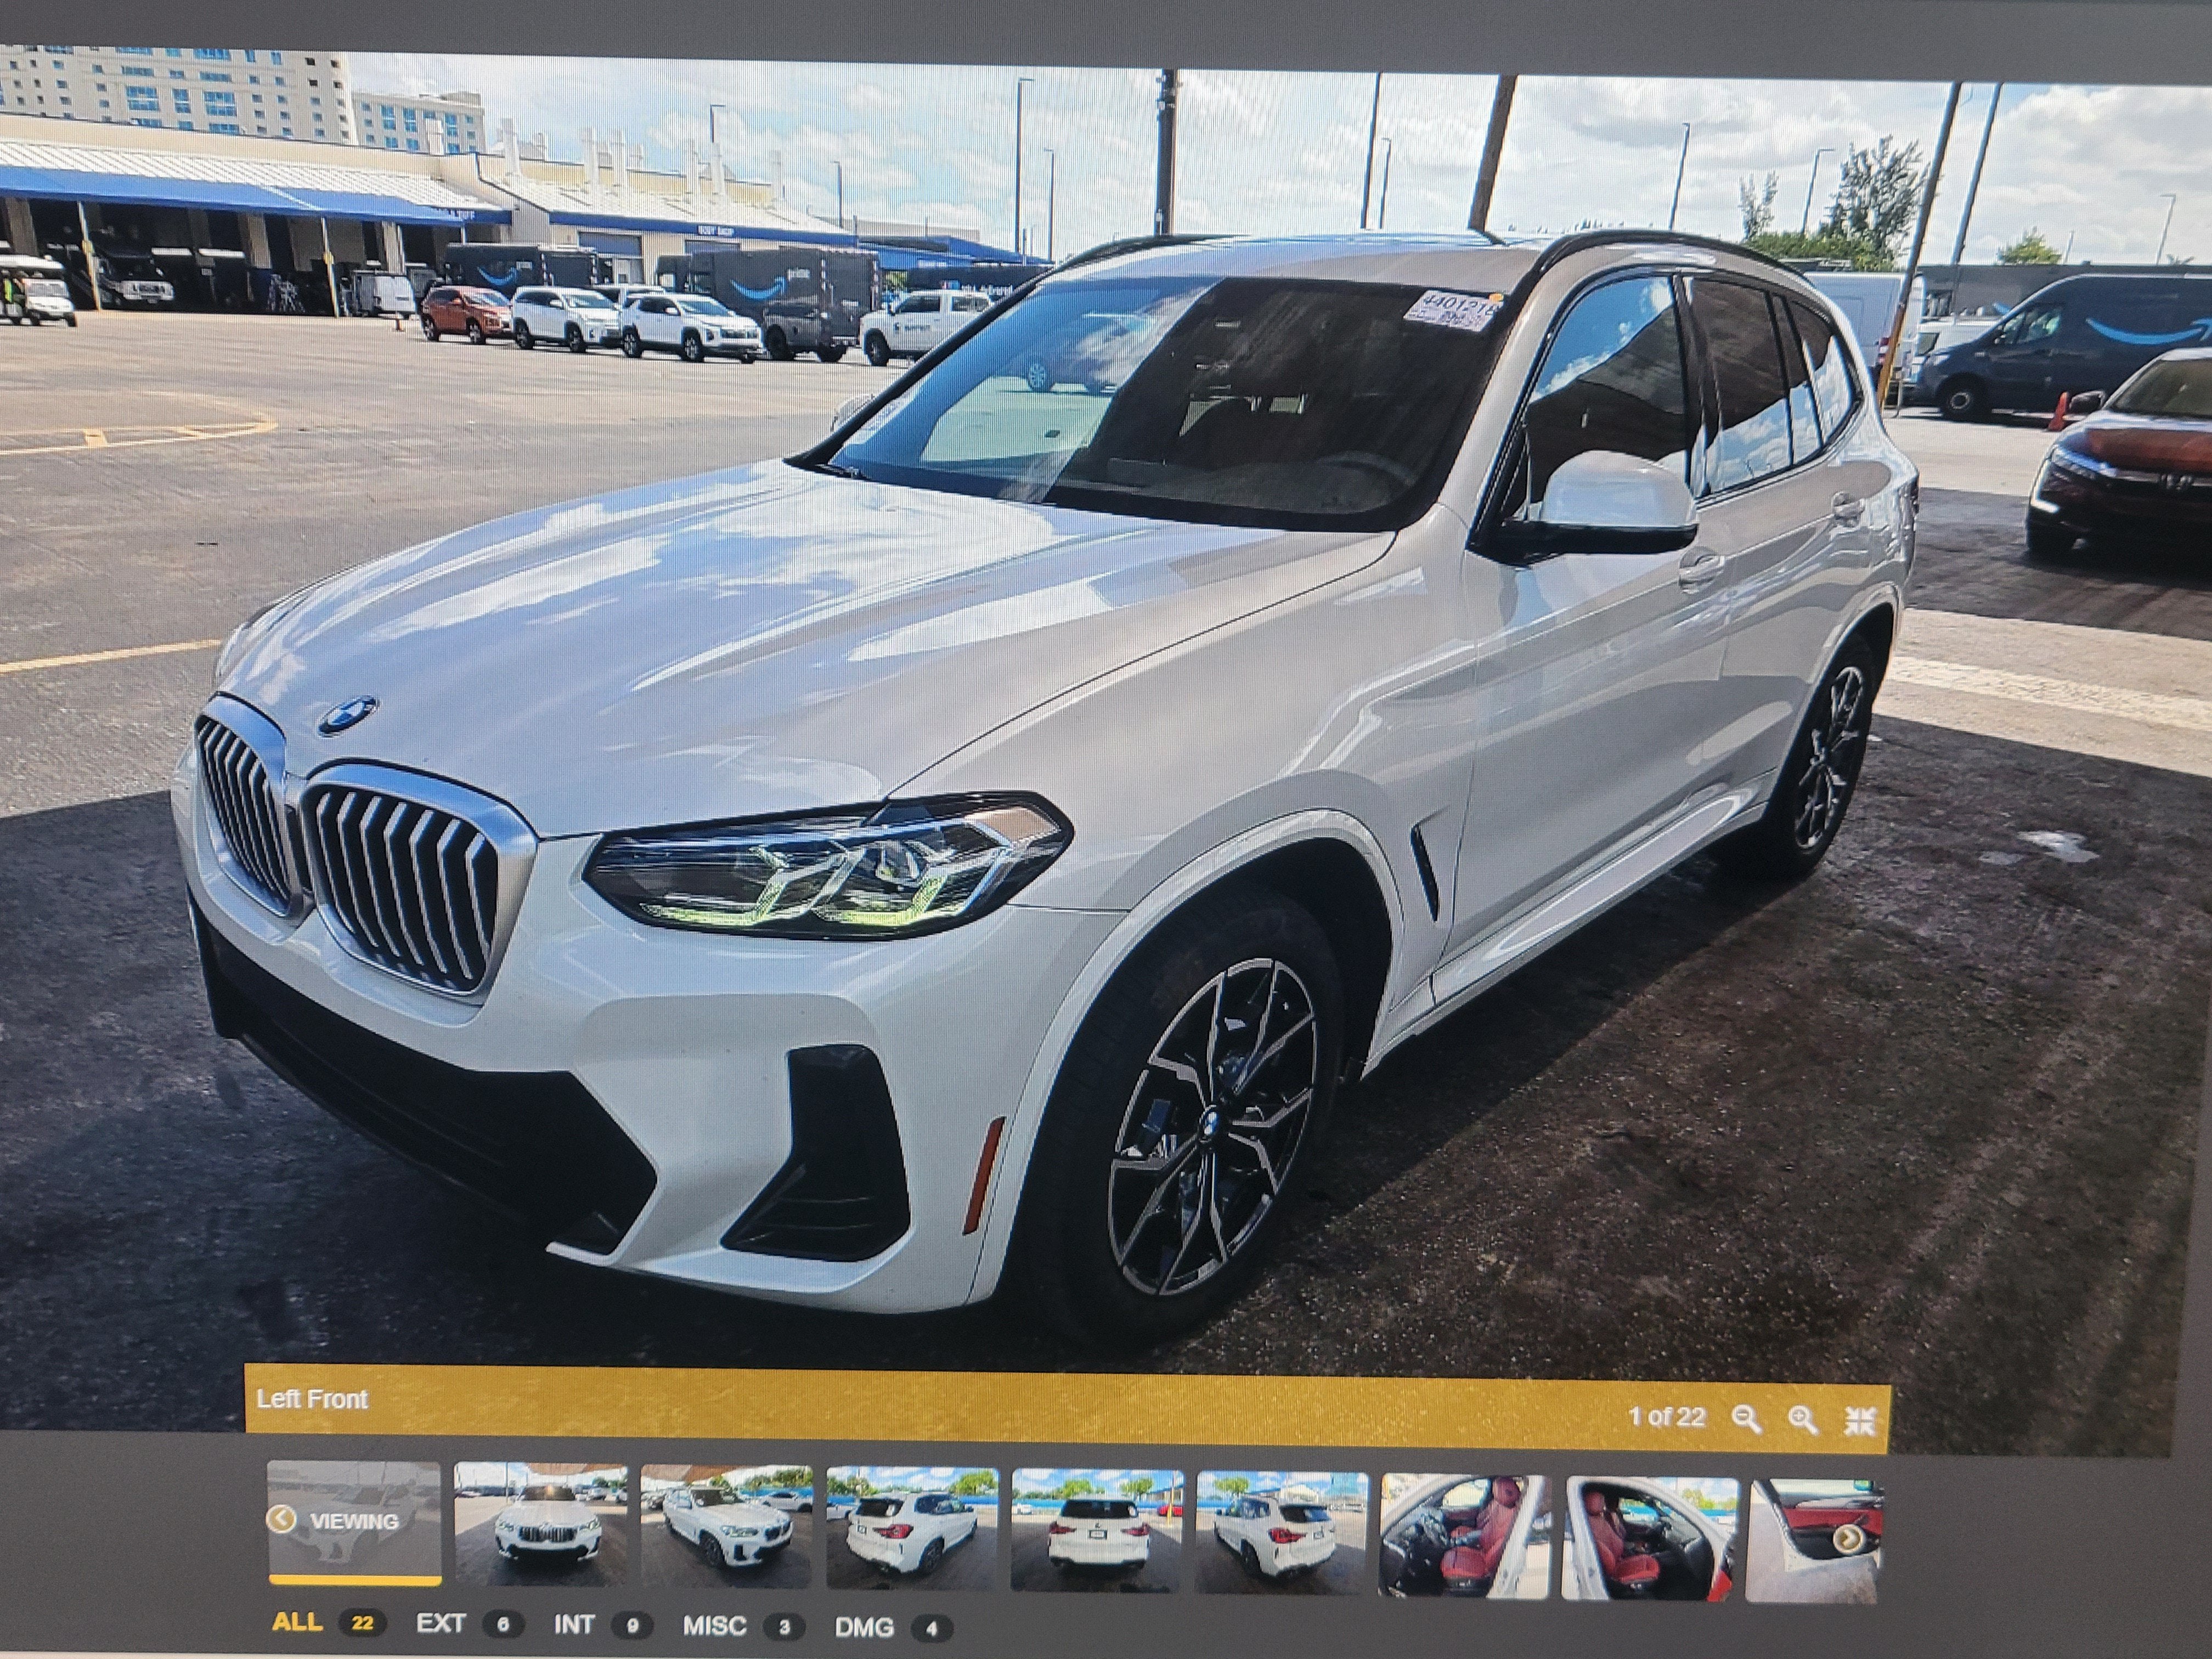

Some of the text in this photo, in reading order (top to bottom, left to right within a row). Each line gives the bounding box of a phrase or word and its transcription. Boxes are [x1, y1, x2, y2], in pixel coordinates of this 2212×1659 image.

[257, 1388, 369, 1409] Left Front
[1629, 1405, 1706, 1426] 1 of 22
[310, 1513, 399, 1530] VIEWING
[272, 1612, 374, 1631] ALL 22
[417, 1613, 509, 1633] EXT 6
[555, 1614, 639, 1634] INT 9
[684, 1615, 791, 1637] MISC 3
[836, 1616, 937, 1638] DMG 4
